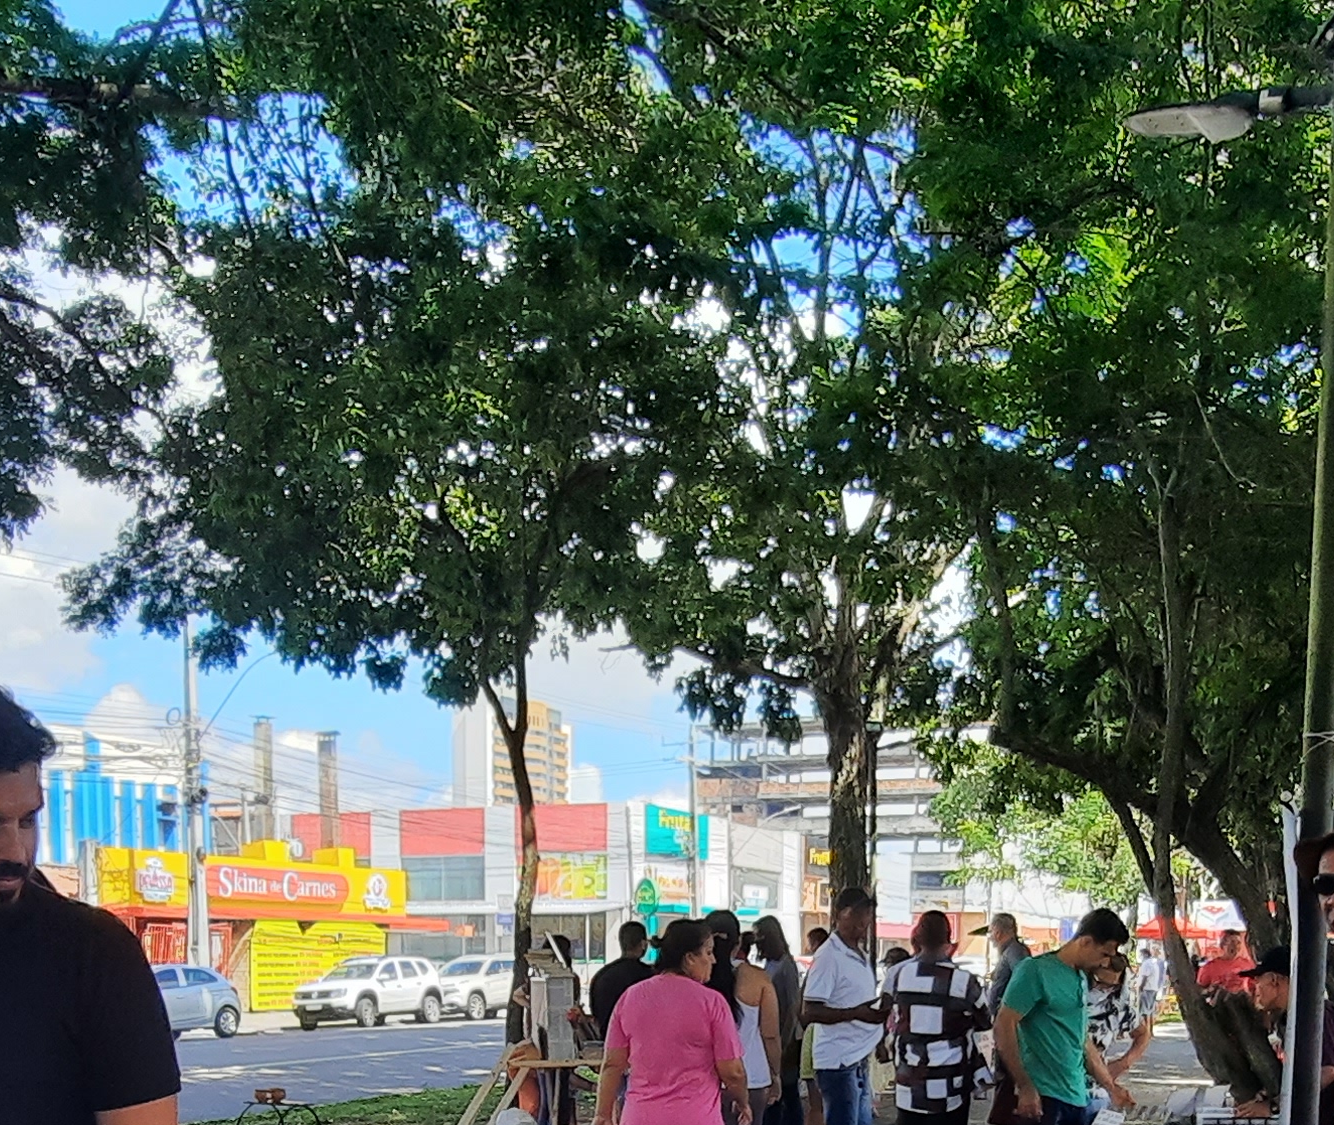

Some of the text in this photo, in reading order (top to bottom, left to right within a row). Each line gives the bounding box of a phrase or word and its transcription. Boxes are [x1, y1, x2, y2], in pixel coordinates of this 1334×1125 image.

[218, 865, 337, 901] Skina de Carnes
